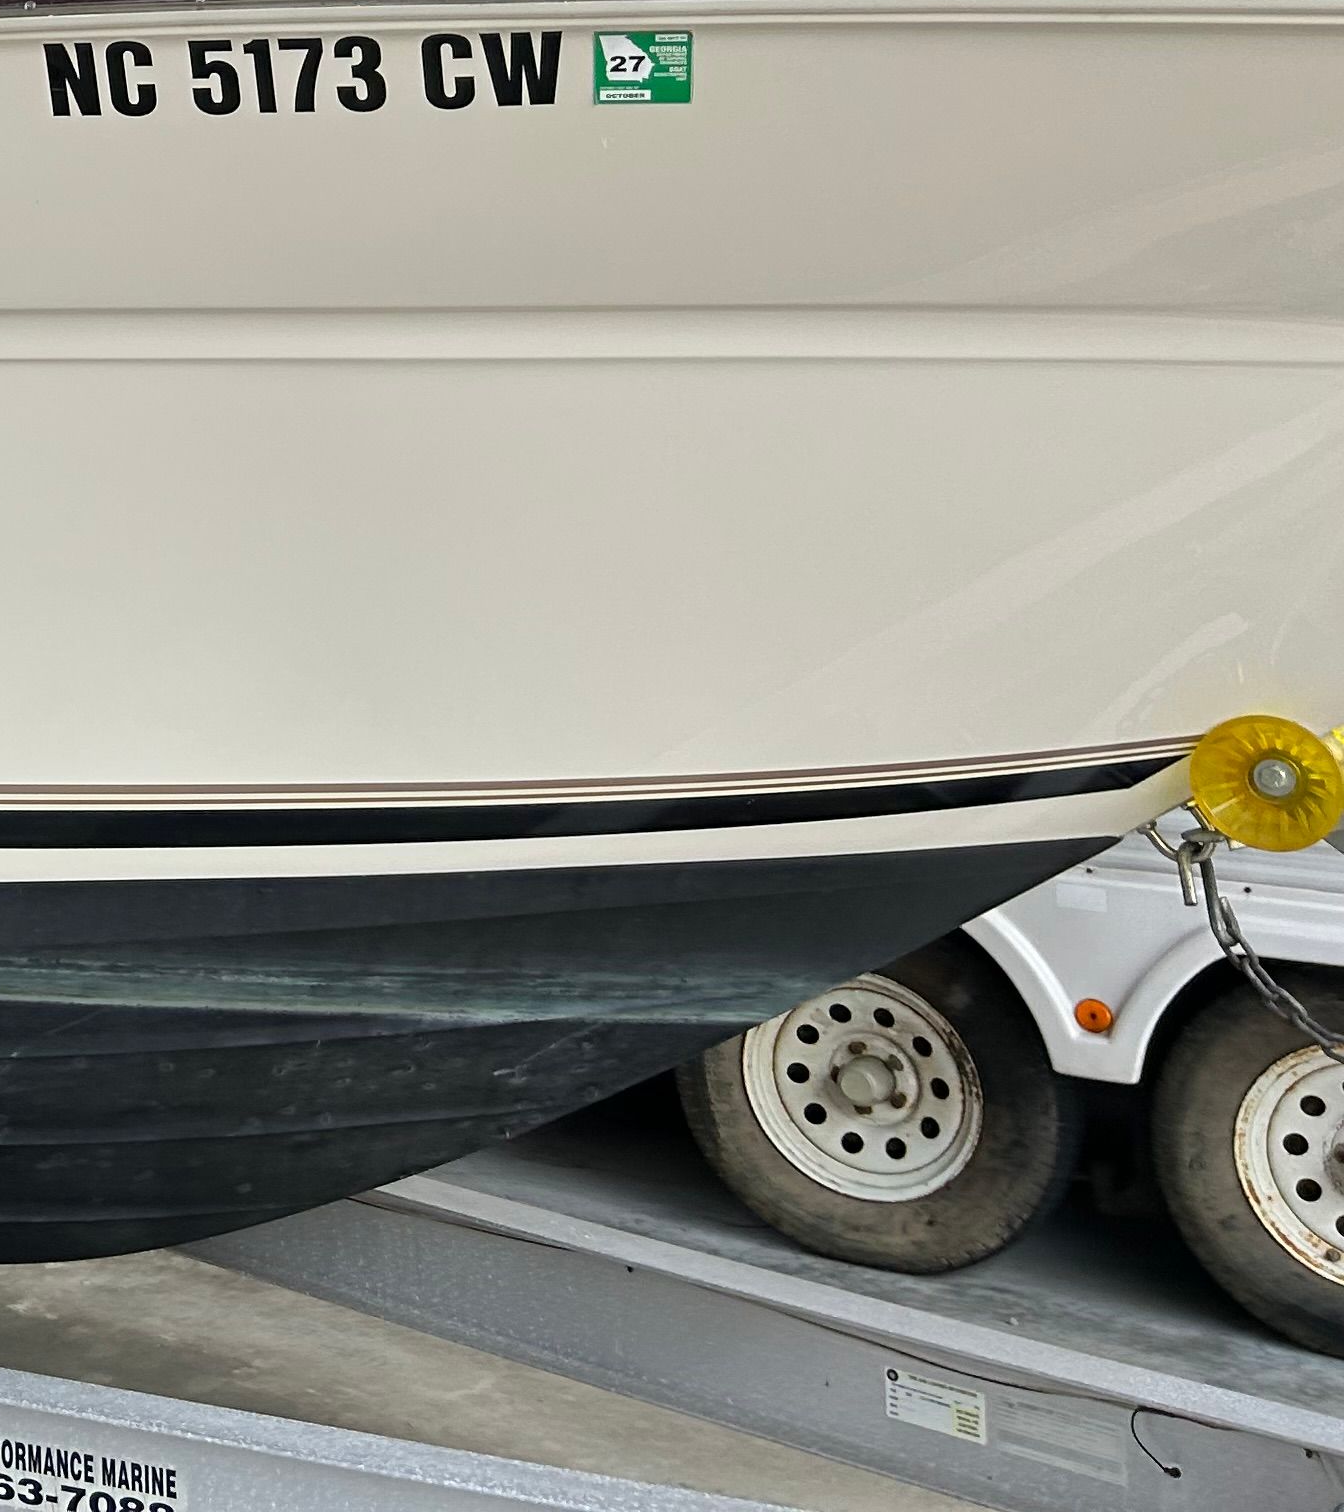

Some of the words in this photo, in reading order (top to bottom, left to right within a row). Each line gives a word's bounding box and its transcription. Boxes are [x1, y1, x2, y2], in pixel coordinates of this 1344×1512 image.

[609, 55, 646, 73] 27
[649, 45, 687, 54] GEORGIA
[43, 40, 158, 117] NC
[187, 35, 388, 116] 5173
[420, 30, 564, 110] CW
[101, 1456, 178, 1499] MARINE
